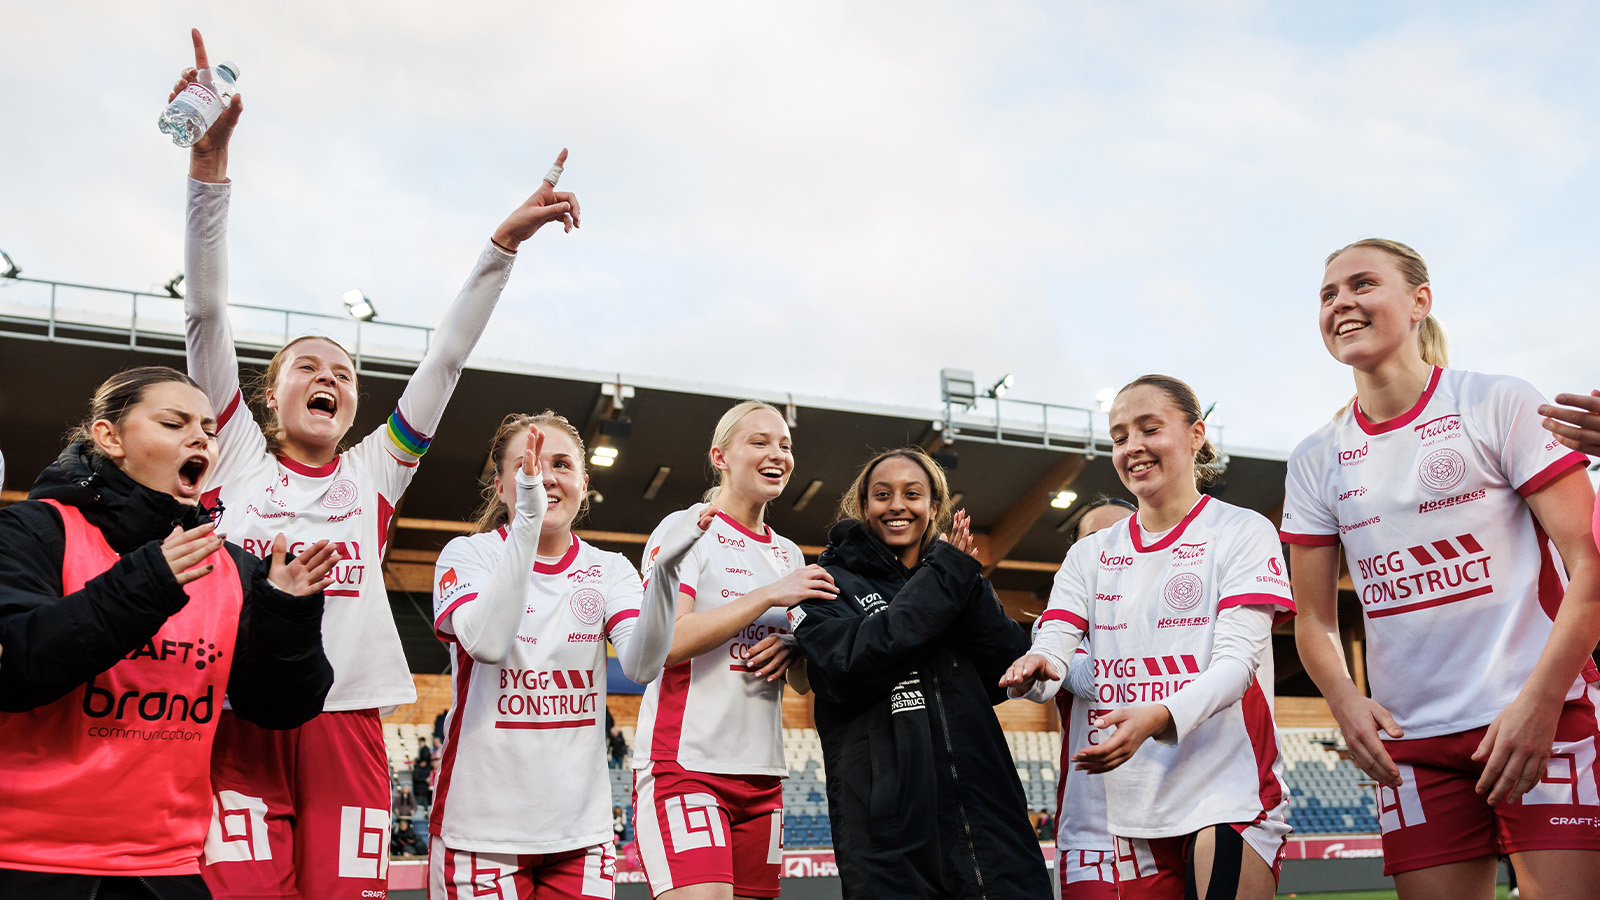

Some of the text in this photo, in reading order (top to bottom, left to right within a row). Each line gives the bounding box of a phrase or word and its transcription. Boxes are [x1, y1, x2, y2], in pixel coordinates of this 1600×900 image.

[1414, 414, 1462, 440] Triller
[1338, 441, 1368, 465] rand
[1339, 489, 1360, 501] RAFT
[1419, 488, 1486, 514] HÖGBERGS
[1358, 551, 1405, 580] BYGG
[1363, 556, 1491, 605] CONSTRUCT
[129, 638, 194, 664] AFT
[500, 668, 548, 691] BYGG
[83, 676, 214, 724] brand
[498, 692, 598, 715] CONSTRUCT
[891, 698, 925, 710] NSTRUCT
[88, 726, 202, 742] communication
[1550, 817, 1593, 825] CRAFT
[361, 889, 383, 898] CRAFT
